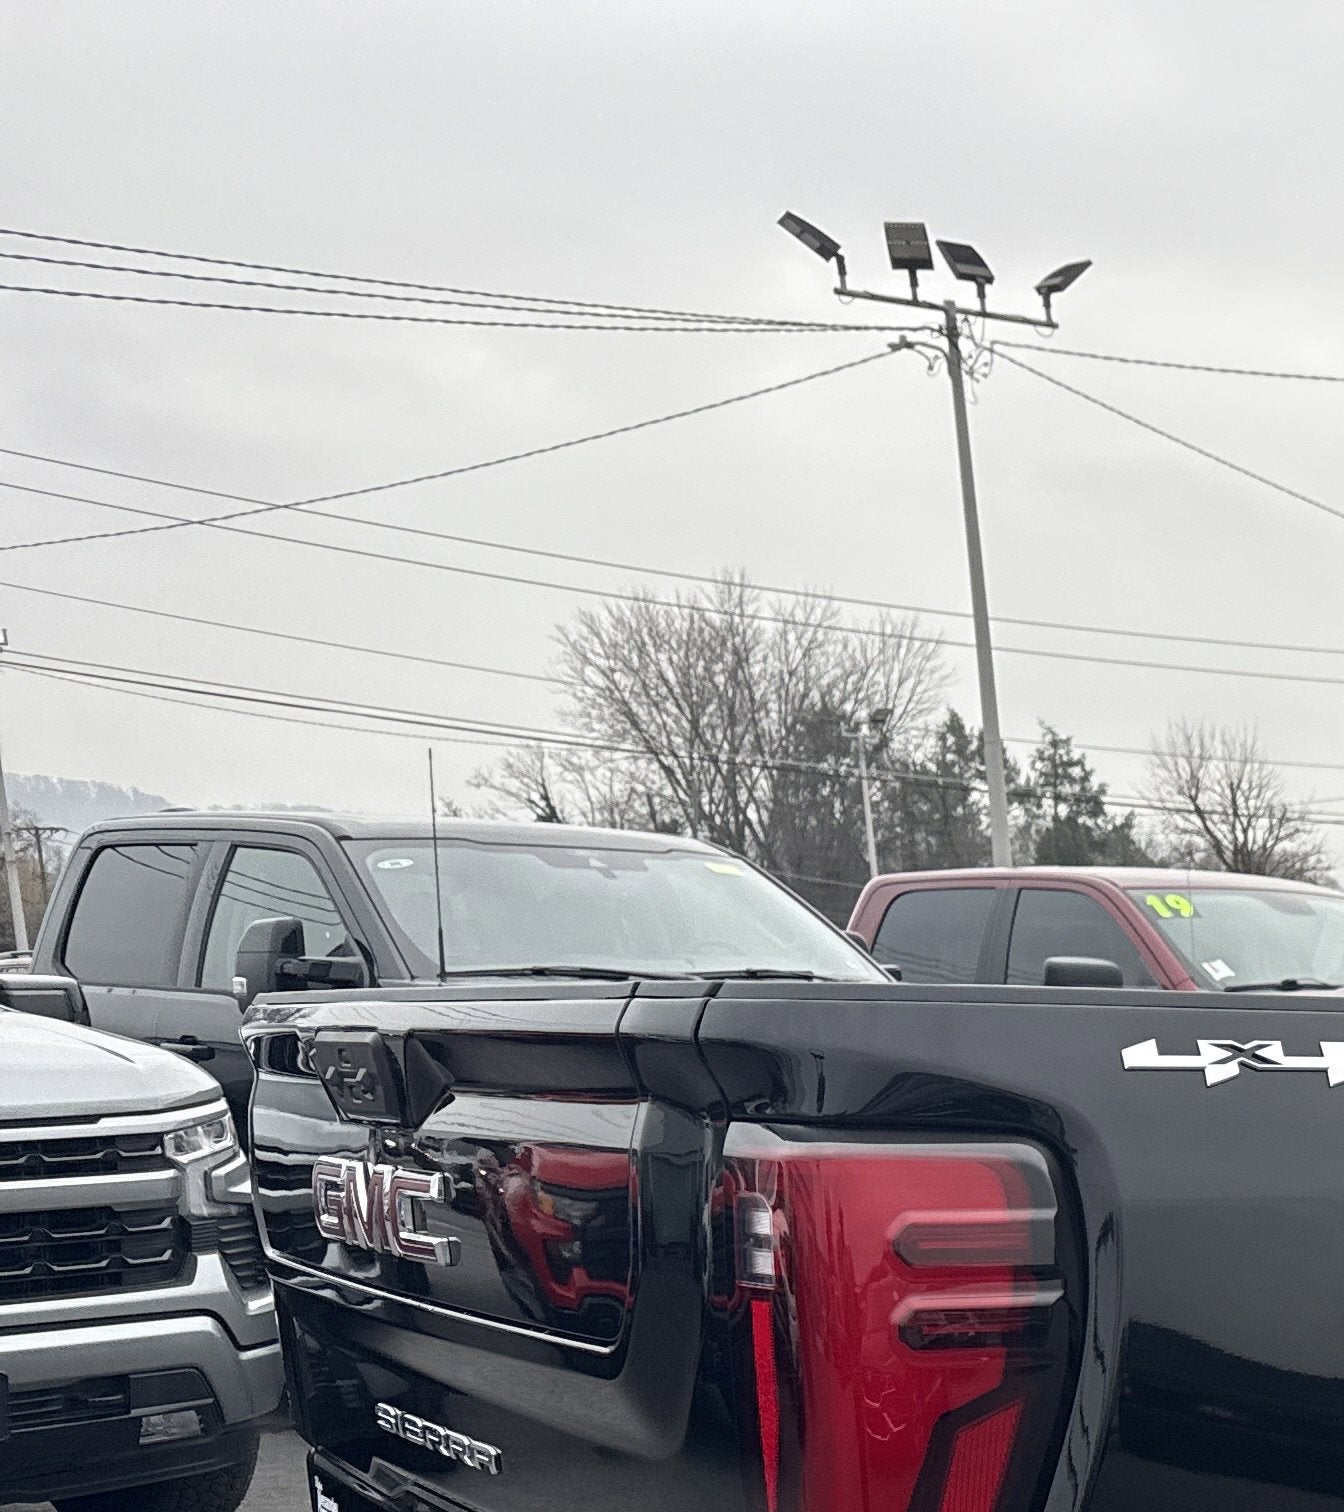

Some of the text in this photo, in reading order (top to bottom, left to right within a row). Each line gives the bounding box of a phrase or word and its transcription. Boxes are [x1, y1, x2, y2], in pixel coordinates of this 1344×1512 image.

[1146, 893, 1194, 918] 19
[312, 1155, 462, 1267] GMC
[374, 1402, 503, 1475] SIERRA
